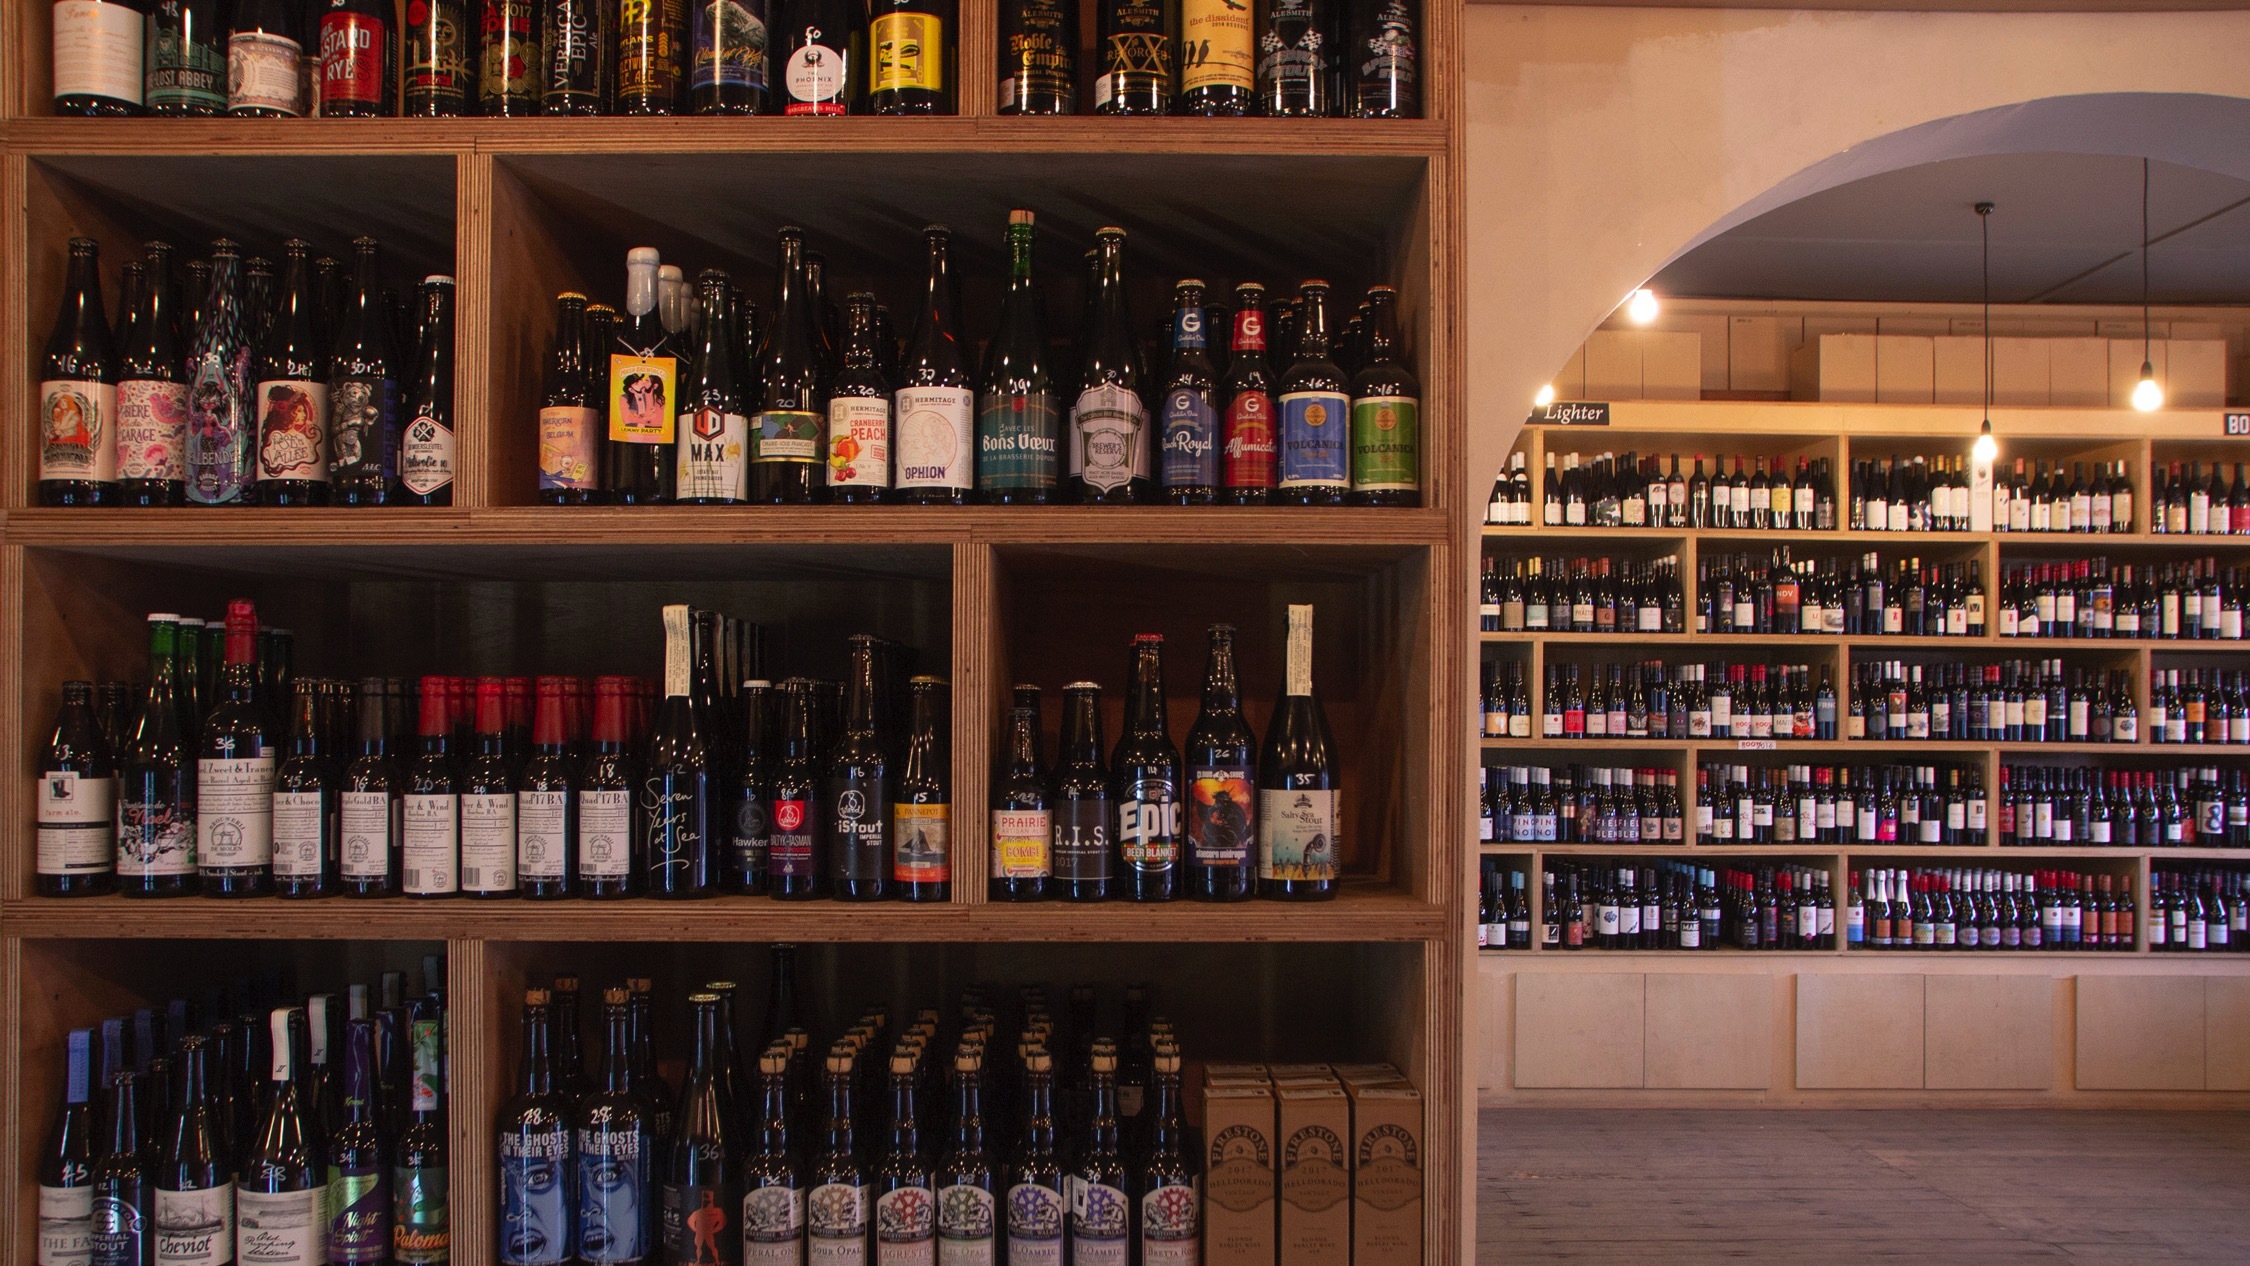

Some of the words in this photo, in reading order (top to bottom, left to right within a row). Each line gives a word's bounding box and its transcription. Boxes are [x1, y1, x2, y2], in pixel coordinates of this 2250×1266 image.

[500, 3, 532, 18] 2017
[1021, 10, 1064, 19] ALESMITH
[1116, 8, 1160, 17] ALESMITH
[1270, 9, 1311, 18] ALESMITH
[1189, 16, 1206, 26] the
[1205, 13, 1249, 26] dissident
[1377, 13, 1412, 24] ALESMITH
[570, 14, 587, 60] EPIC
[588, 32, 598, 49] Ale
[1010, 33, 1053, 55] Noble
[326, 58, 354, 82] RYE
[155, 70, 176, 88] LOST
[178, 69, 214, 90] ABBEY
[204, 352, 220, 363] 30
[60, 354, 77, 374] 16
[351, 362, 366, 374] 30
[701, 388, 721, 401] 23
[858, 385, 875, 395] 20
[1381, 383, 1394, 396] 16
[775, 398, 796, 408] 20
[123, 401, 151, 418] BIÈRE
[1543, 404, 1604, 424] Lighter
[543, 417, 572, 427] AMERICAN
[850, 419, 885, 427] CRANBERRY
[1023, 424, 1035, 432] LES
[121, 428, 157, 444] GARAGE
[546, 430, 574, 440] BELGIUM
[641, 427, 663, 435] PARTY
[850, 428, 886, 441] PEACH
[982, 434, 1015, 452] Bons
[1176, 430, 1213, 457] Royal
[1286, 439, 1344, 450] VOLCANICA
[1356, 444, 1416, 454] VOLCANICA
[691, 443, 725, 462] MAX
[998, 453, 1034, 461] BRASSERIE
[905, 466, 946, 480] OPHION
[214, 737, 236, 750] 36
[1214, 749, 1230, 759] 26
[207, 762, 233, 774] Zweet
[600, 761, 615, 777] 18
[233, 776, 252, 786] Aged
[288, 774, 303, 788] 15
[415, 777, 434, 792] 20
[1295, 773, 1316, 785] 35
[536, 781, 548, 791] 18
[546, 793, 563, 805] BA
[613, 793, 628, 805] BA
[640, 777, 694, 809] Seven
[293, 795, 321, 805] Choco
[353, 795, 372, 805] Gold
[372, 795, 386, 805] BA
[417, 800, 424, 810] &
[428, 800, 449, 811] Wind
[476, 799, 483, 809] &
[488, 798, 509, 809] Wind
[904, 808, 939, 816] PANNEPOT
[1281, 810, 1300, 820] Salty
[1301, 810, 1315, 819] Sea
[1002, 816, 1046, 827] PRAIRIE
[1119, 795, 1181, 845] Epic
[1299, 815, 1324, 825] Stout
[648, 807, 687, 849] Years
[838, 820, 883, 833] iStout
[660, 826, 702, 854] Sea
[732, 836, 769, 847] Hawker
[770, 834, 812, 846] BALTYK-TASMAN
[1055, 825, 1110, 846] R.I.S.
[1006, 845, 1040, 857] BOMB!
[1126, 847, 1145, 858] BEER
[1145, 846, 1177, 857] BLANKET
[1055, 857, 1078, 867] 2017
[523, 1107, 542, 1125] 28
[590, 1105, 610, 1124] 28
[502, 1131, 521, 1146] THE
[524, 1129, 569, 1146] GHOSTS
[578, 1128, 591, 1142] THE
[593, 1129, 640, 1145] GHOSTS
[1359, 1125, 1416, 1160] FIRESTONE
[513, 1145, 543, 1158] THEIR
[546, 1141, 569, 1156] EYES
[585, 1143, 611, 1156] THEIR
[614, 1142, 640, 1155] EYES
[1213, 1126, 1268, 1161] FIRESTONE
[1287, 1126, 1343, 1161] FIRESTONE
[699, 1142, 720, 1160] 36
[1302, 1166, 1327, 1174] 2017
[1376, 1165, 1400, 1173] 2017
[98, 1182, 109, 1191] 12
[1209, 1177, 1272, 1189] HELLDORADO
[1284, 1177, 1346, 1189] HELLDORADO
[1357, 1177, 1419, 1187] HELLDORADO
[343, 1211, 382, 1229] Night
[42, 1237, 68, 1248] THE
[244, 1235, 296, 1248] Pumping
[257, 1232, 281, 1241] Old
[334, 1227, 374, 1246] Spirit
[393, 1224, 450, 1250] Paloma
[836, 1243, 862, 1254] OPAL
[1148, 1246, 1180, 1258] BRETTA
